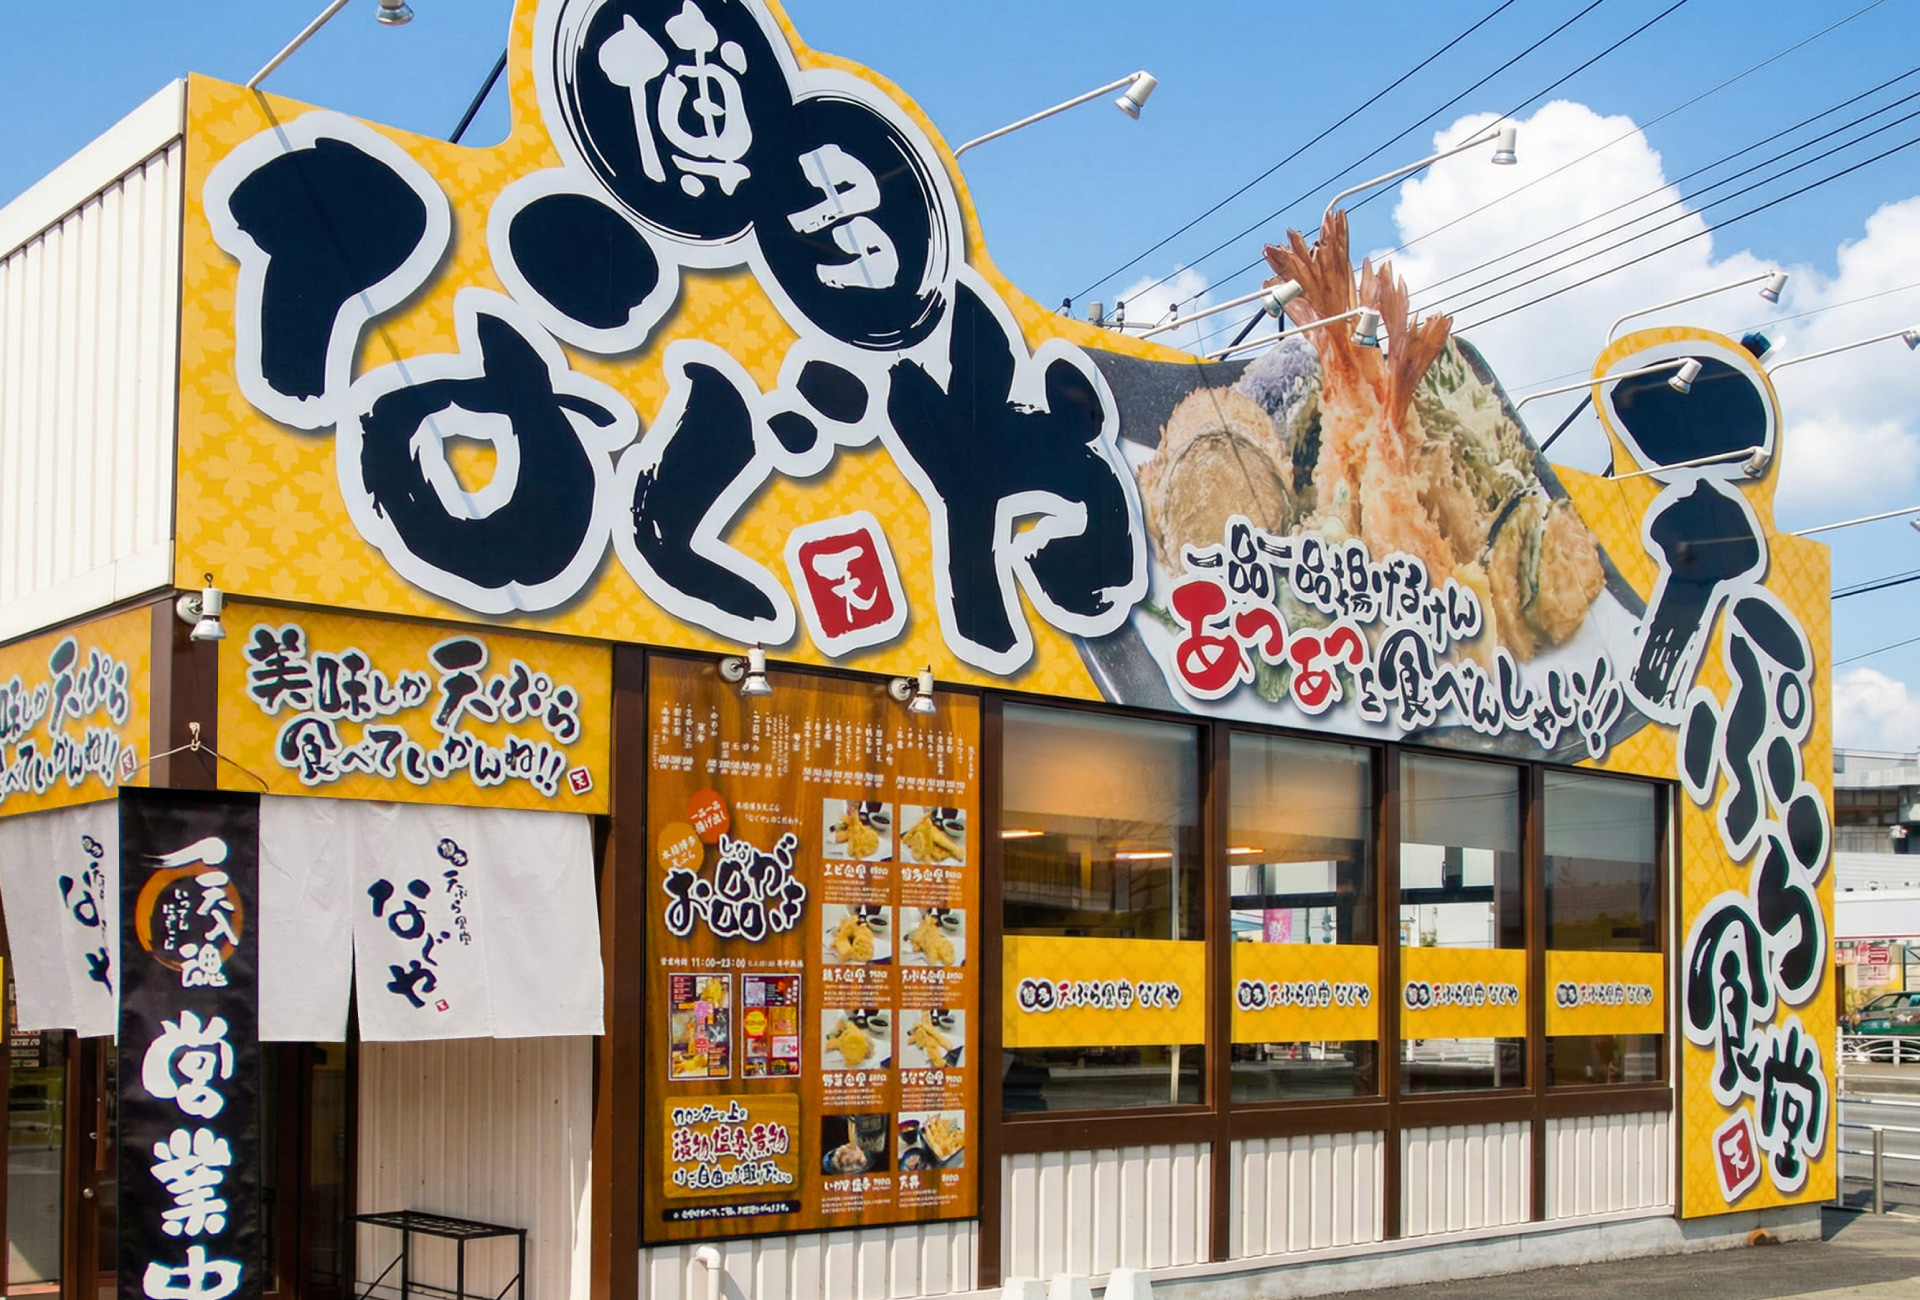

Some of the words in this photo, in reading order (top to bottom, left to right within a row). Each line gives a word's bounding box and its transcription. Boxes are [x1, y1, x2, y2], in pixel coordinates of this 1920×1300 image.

[227, 138, 1134, 653] なぐや
[0, 731, 118, 797] べていかんね!!
[247, 628, 576, 738] 美味しか天ぷら
[1608, 354, 1824, 1178] 天ぷら食堂
[367, 878, 451, 1009] なぐや
[141, 1008, 244, 1300] 営業中
